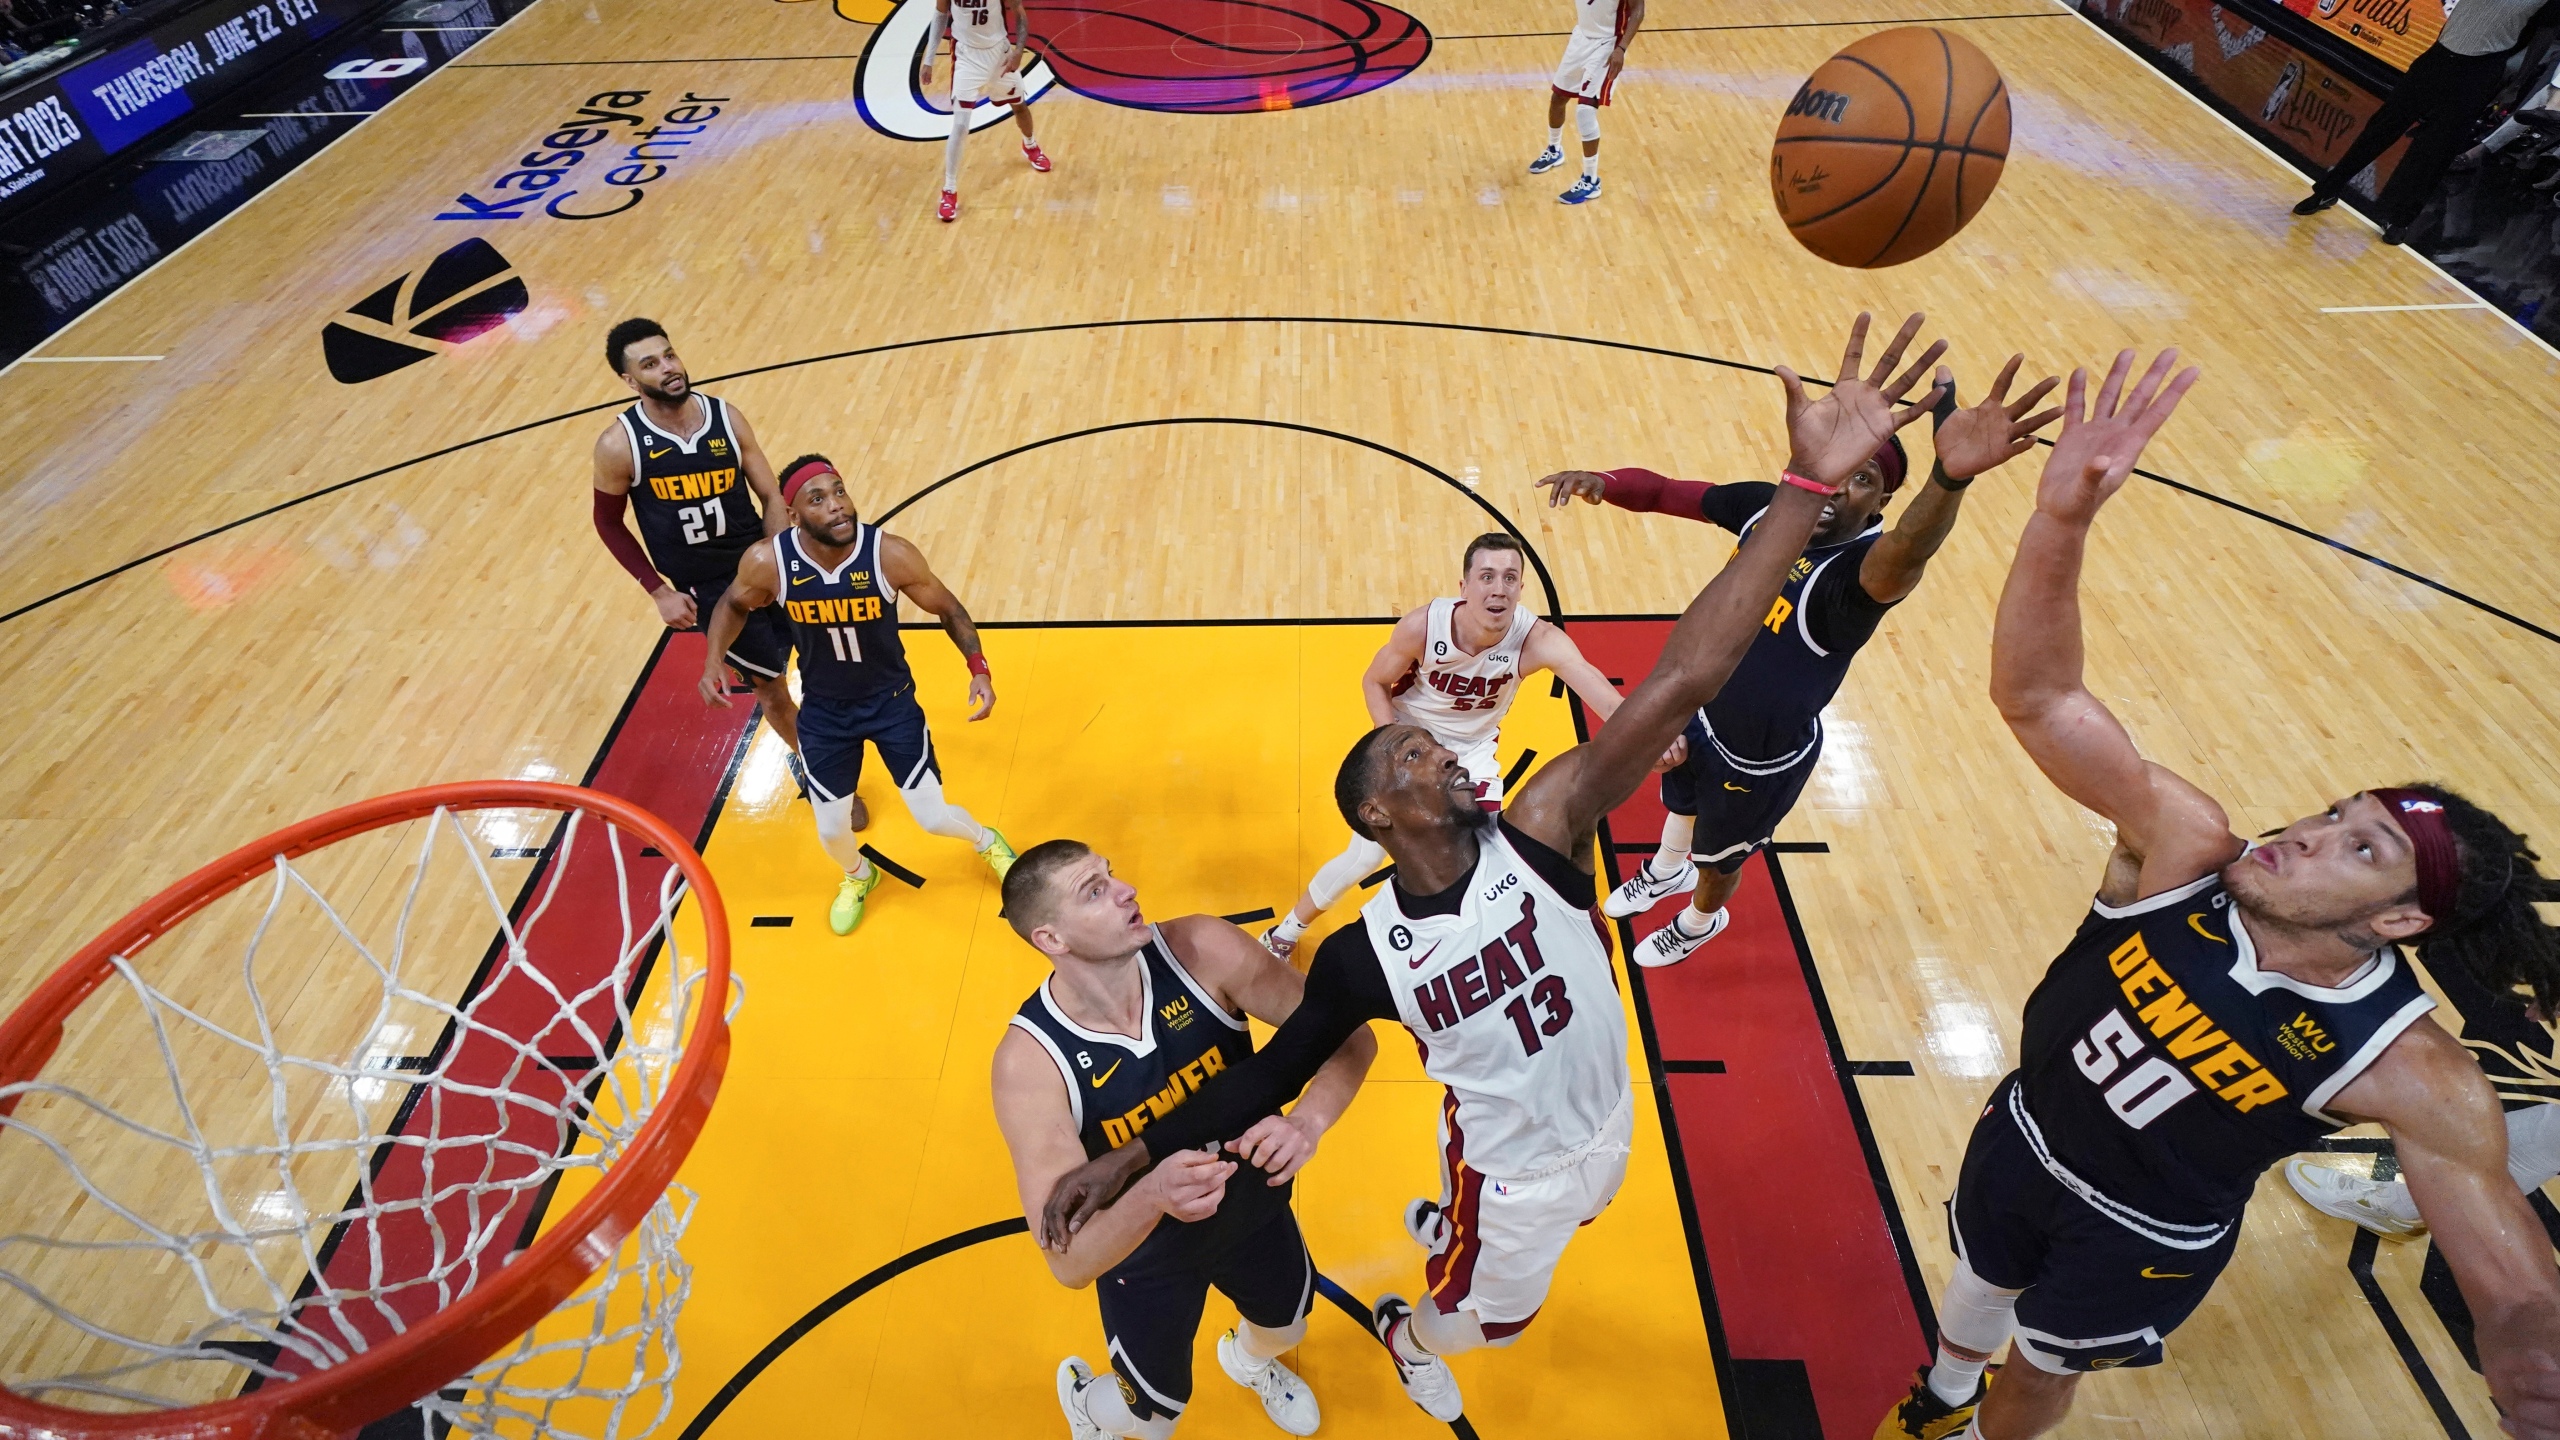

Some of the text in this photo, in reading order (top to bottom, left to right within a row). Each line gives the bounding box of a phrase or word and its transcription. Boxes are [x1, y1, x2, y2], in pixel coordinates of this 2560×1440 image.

[971, 9, 989, 26] 16
[92, 41, 215, 121] THURSDAY,
[204, 16, 258, 66] JUNE
[246, 4, 282, 42] 22
[275, 0, 298, 27] 8
[13, 95, 82, 159] 2023
[433, 90, 652, 221] Kaseya
[545, 92, 731, 220] Center
[643, 435, 654, 447] 6
[708, 438, 726, 448] WU
[649, 468, 736, 500] DENVER
[678, 496, 727, 545] 27
[790, 560, 800, 572] 6
[850, 571, 869, 582] WU
[786, 596, 882, 624] DENVER
[827, 626, 862, 663] 11
[1428, 670, 1514, 698] HEAT
[1393, 927, 1410, 948] 6
[1413, 891, 1546, 1033] HEAT
[1160, 995, 1189, 1020] WU
[1167, 1009, 1195, 1028] Western
[1504, 974, 1574, 1057] 13
[2108, 930, 2289, 1115] DENVER
[1175, 1017, 1194, 1031] Union
[2292, 1011, 2336, 1052] WU
[2276, 1033, 2304, 1060] Union
[2279, 1022, 2317, 1060] Western
[1076, 1051, 1093, 1069] 6
[2071, 1005, 2199, 1130] 50
[1101, 1045, 1228, 1149] DENVER
